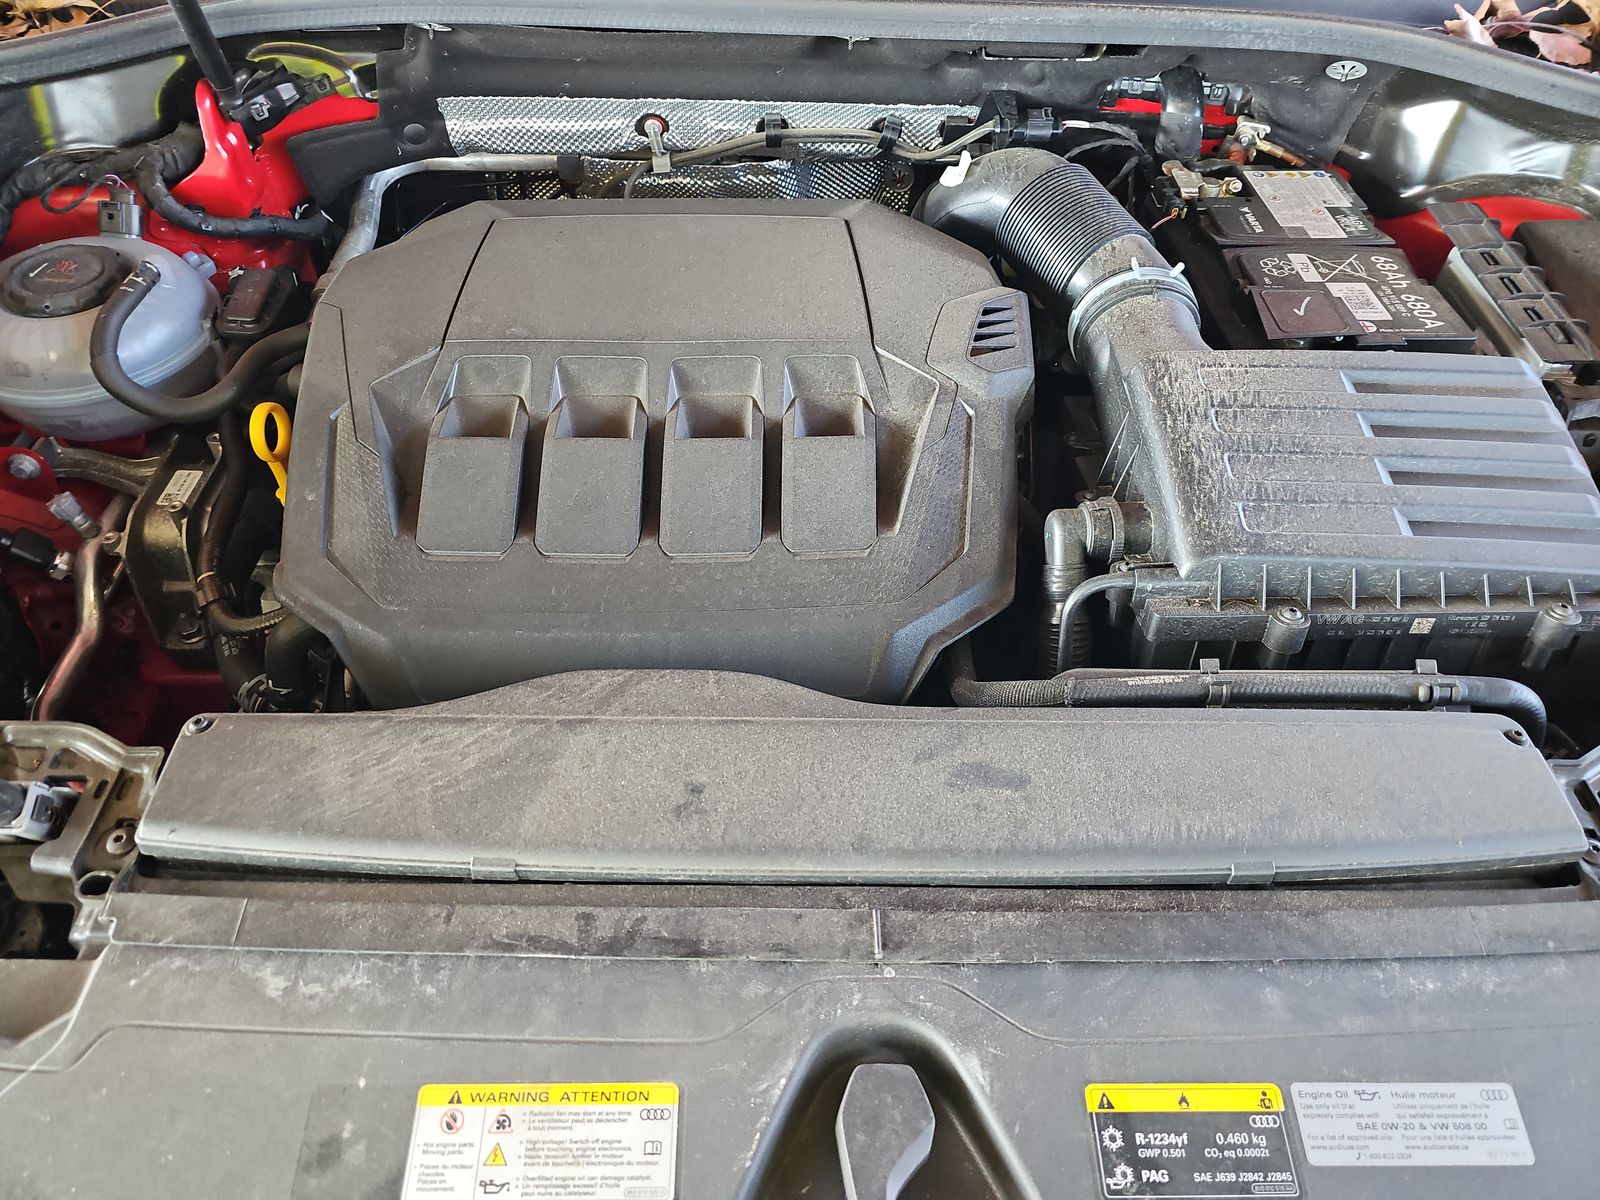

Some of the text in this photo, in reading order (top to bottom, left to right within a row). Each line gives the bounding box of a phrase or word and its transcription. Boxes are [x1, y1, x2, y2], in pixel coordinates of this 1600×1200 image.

[1245, 212, 1264, 233] VARTA
[1347, 214, 1368, 231] AGM
[1296, 262, 1310, 273] Pb
[1370, 255, 1411, 288] 68Ah
[1400, 294, 1445, 329] 680A
[1317, 614, 1341, 624] VW
[1341, 614, 1365, 624] AG
[470, 1090, 650, 1103] WARNING ATTENTION
[1298, 1090, 1349, 1100] Engine Oil
[1390, 1090, 1456, 1099] Huile moteur
[1315, 1103, 1329, 1111] only
[1356, 1122, 1488, 1131] SAE 0W-20 & VW 508 00
[1134, 1132, 1189, 1148] R-1234yf
[1215, 1132, 1267, 1147] 0.460 kg
[1137, 1148, 1186, 1158] GWP 0.501
[1223, 1149, 1236, 1159] eq
[1236, 1148, 1270, 1157] 0.0002t
[1141, 1169, 1170, 1183] PAG
[1193, 1172, 1293, 1182] SAE J639 J2842 J2845
